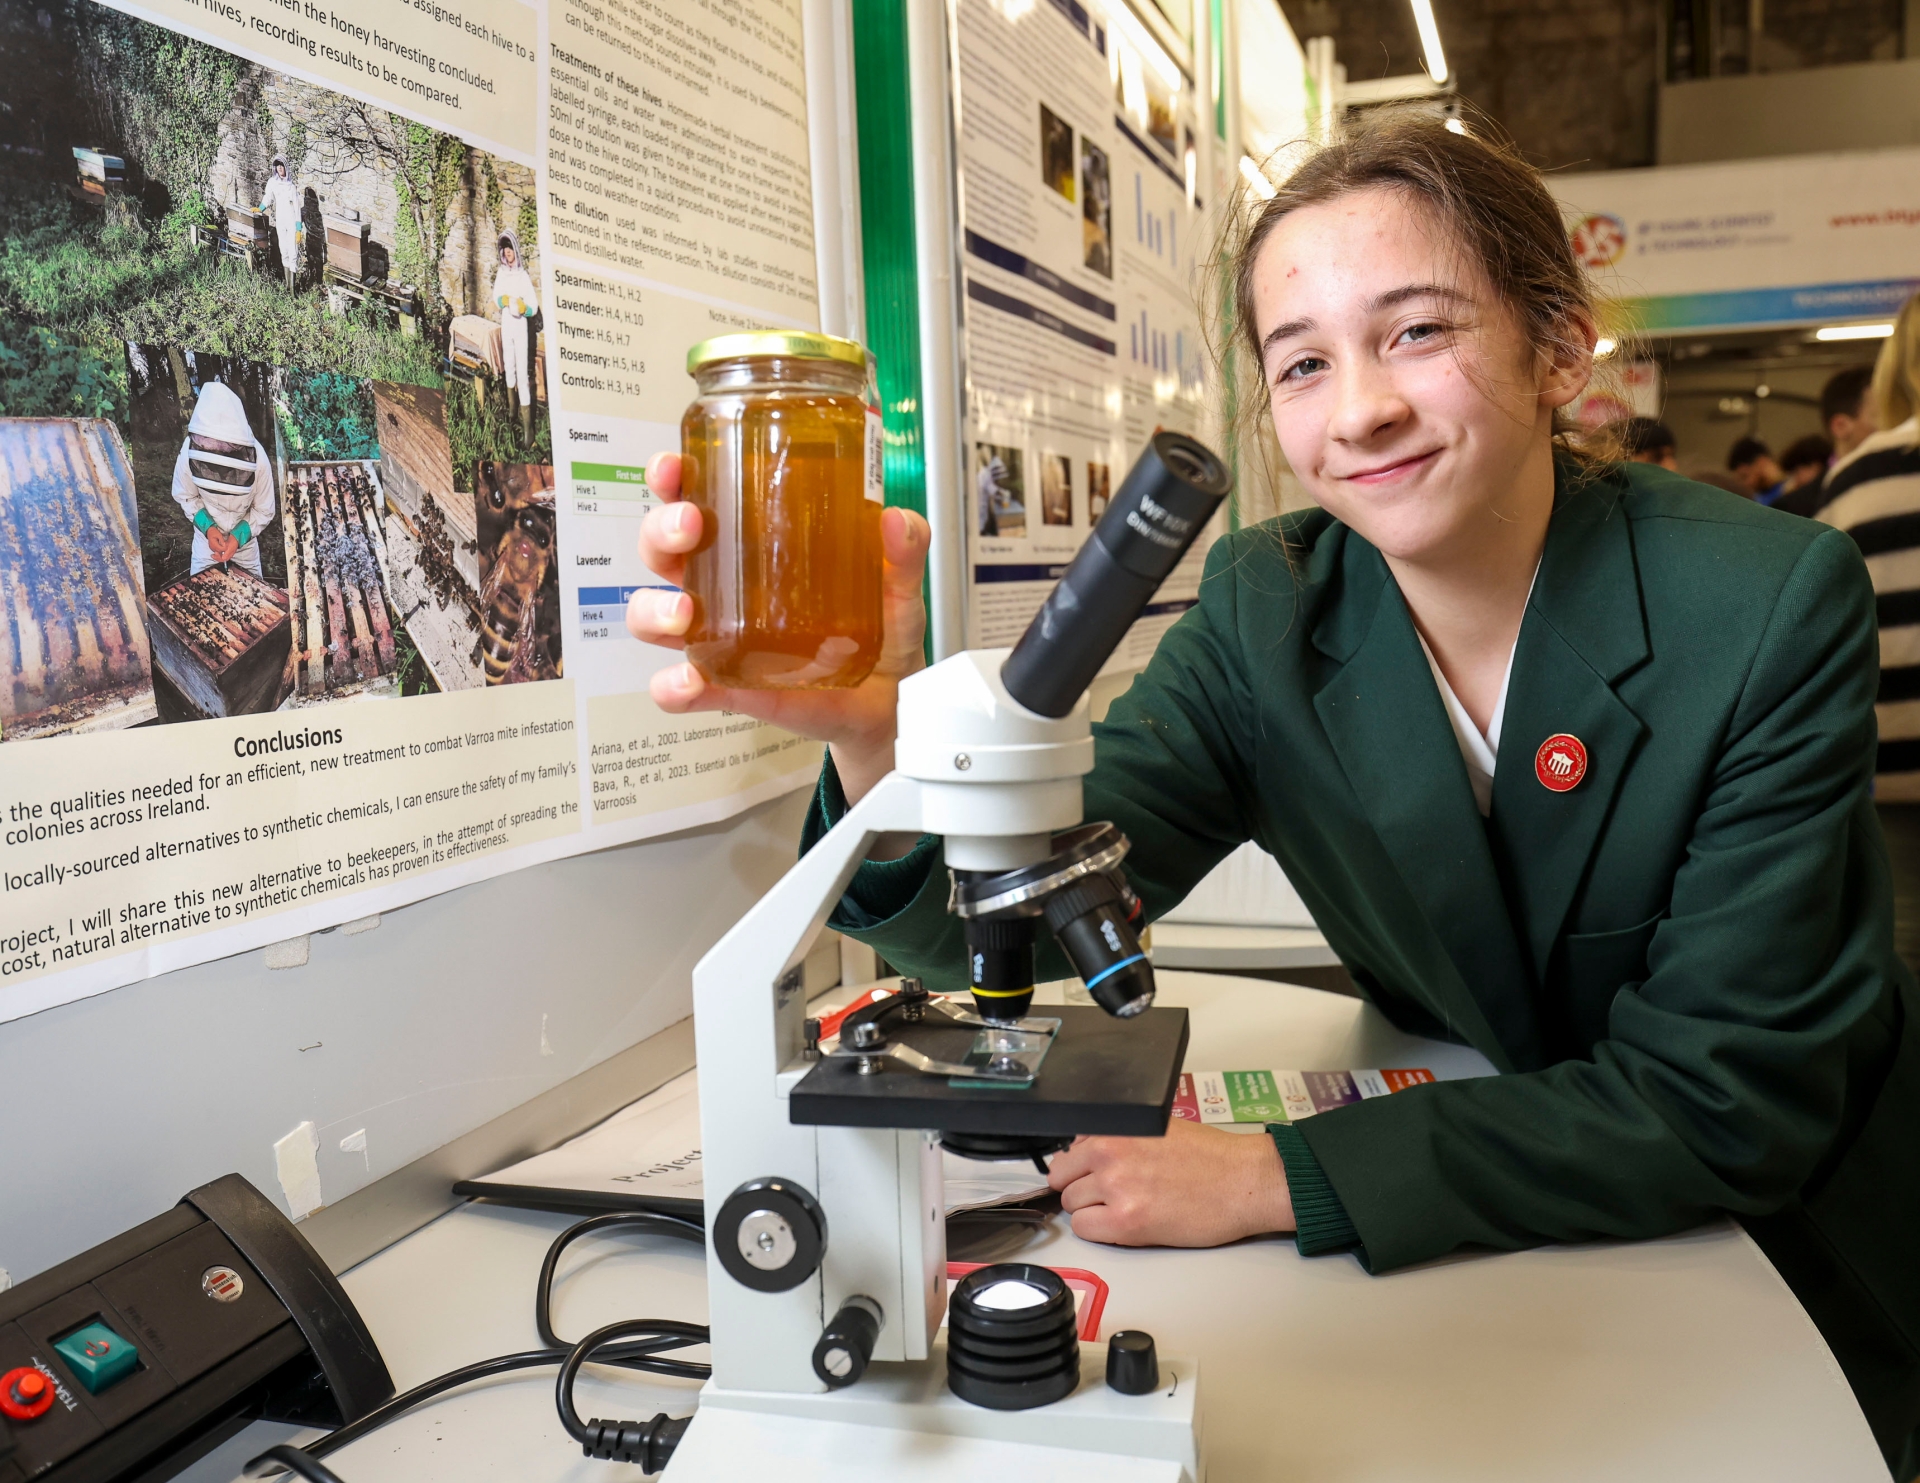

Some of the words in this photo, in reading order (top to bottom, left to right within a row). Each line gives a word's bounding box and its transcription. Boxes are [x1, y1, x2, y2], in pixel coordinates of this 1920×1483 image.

[414, 0, 461, 28] assigned
[465, 20, 488, 41] each
[492, 30, 513, 52] hive
[516, 42, 526, 58] to
[529, 51, 535, 62] a
[566, 12, 581, 29] can
[583, 18, 594, 36] be
[597, 29, 631, 55] returned
[250, 15, 316, 56] recording
[320, 44, 364, 71] results
[366, 60, 380, 78] to
[383, 65, 398, 85] be
[401, 76, 462, 110] compared.
[304, 2, 326, 24] the
[331, 11, 370, 45] honey
[374, 30, 436, 72] harvesting
[439, 61, 496, 94] concluded.
[551, 43, 601, 78] Treatments
[605, 71, 614, 84] of
[617, 76, 639, 96] these
[642, 87, 664, 108] hives.
[551, 67, 589, 92] essential
[594, 86, 608, 102] oils
[613, 96, 628, 110] and
[550, 83, 584, 110] labelled
[587, 103, 619, 127] syringe,
[550, 105, 572, 125] 50ml
[576, 118, 585, 130] of
[588, 123, 621, 146] solution
[549, 126, 570, 145] dose
[573, 136, 582, 149] to
[585, 140, 599, 156] the
[549, 148, 565, 163] and
[569, 156, 586, 171] was
[590, 164, 633, 188] completed
[549, 165, 570, 184] bees
[572, 175, 581, 188] to
[549, 192, 567, 209] The
[574, 201, 609, 222] dilution
[551, 215, 600, 238] mentioned
[553, 233, 582, 251] 100ml
[584, 241, 617, 261] distilled
[619, 254, 644, 269] water.
[555, 270, 607, 293] Spearmint:
[609, 283, 626, 300] H.1,
[628, 289, 641, 303] H.2
[556, 295, 604, 317] Lavender:
[605, 306, 623, 323] H.4,
[625, 311, 644, 326] H.10
[558, 321, 595, 339] Thyme:
[597, 329, 615, 345] H.6,
[617, 333, 630, 346] H.7
[560, 347, 611, 369] Rosemary:
[612, 356, 630, 373] H.5,
[632, 360, 645, 373] H.8
[562, 372, 605, 390] Controls:
[607, 379, 624, 395] H.3,
[626, 382, 640, 396] H.9
[569, 429, 609, 443] Spearmint
[576, 485, 591, 495] Hive
[592, 486, 596, 495] 1
[616, 470, 629, 480] First
[630, 472, 642, 481] test
[577, 502, 592, 511] Hive
[593, 503, 597, 511] 2
[576, 555, 611, 565] Lavender
[583, 611, 597, 620] Hive
[599, 611, 603, 619] 4
[584, 628, 598, 638] Hive
[600, 628, 608, 637] 10
[234, 728, 342, 757] Conclusions
[591, 743, 624, 756] Ariana,
[628, 740, 638, 751] et
[642, 736, 654, 749] al.,
[658, 732, 681, 746] 2002.
[684, 727, 722, 742] Laboratory
[9, 802, 42, 821] the
[50, 789, 125, 820] qualities
[132, 775, 193, 802] needed
[199, 774, 220, 790] for
[226, 772, 242, 786] an
[248, 760, 305, 782] efficient,
[310, 756, 338, 772] new
[343, 744, 406, 766] treatment
[409, 743, 420, 755] to
[424, 735, 462, 753] combat
[465, 730, 494, 746] Varroa
[498, 726, 518, 740] mite
[521, 719, 574, 736] infestation
[591, 761, 623, 775] Varroa
[626, 752, 672, 769] destructor.
[593, 781, 618, 793] Bava,
[624, 776, 635, 788] R.,
[640, 773, 649, 784] et
[654, 769, 664, 782] al,
[669, 765, 691, 779] 2023.
[695, 757, 726, 773] Essential
[594, 793, 637, 811] Varroosis
[5, 846, 140, 891] locally-sourced
[146, 831, 240, 861] alternatives
[244, 827, 258, 842] to
[262, 811, 323, 840] synthetic
[327, 798, 393, 824] chemicals,
[397, 796, 400, 809] I
[403, 795, 422, 808] can
[425, 787, 459, 803] ensure
[462, 781, 477, 795] the
[479, 775, 506, 791] safety
[509, 771, 518, 784] of
[521, 771, 535, 783] my
[538, 761, 576, 779] family's
[6, 819, 85, 845] colonies
[90, 808, 143, 830] across
[148, 794, 210, 819] Ireland.
[70, 919, 73, 935] I
[82, 908, 111, 932] will
[120, 900, 166, 922] share
[174, 890, 205, 910] this
[212, 882, 243, 901] new
[250, 863, 322, 892] alternative
[328, 859, 341, 872] to
[348, 841, 418, 868] beekeepers,
[423, 835, 432, 849] in
[437, 830, 454, 845] the
[458, 820, 494, 840] attempt
[498, 814, 507, 829] of
[510, 806, 557, 827] spreading
[561, 801, 578, 814] the
[1, 951, 46, 976] cost,
[52, 928, 115, 962] natural
[120, 910, 211, 944] alternative
[215, 905, 230, 920] to
[235, 886, 297, 917] synthetic
[301, 869, 365, 897] chemicals
[368, 865, 390, 881] has
[393, 854, 429, 878] proven
[432, 849, 444, 863] its
[447, 832, 509, 859] effectiveness.
